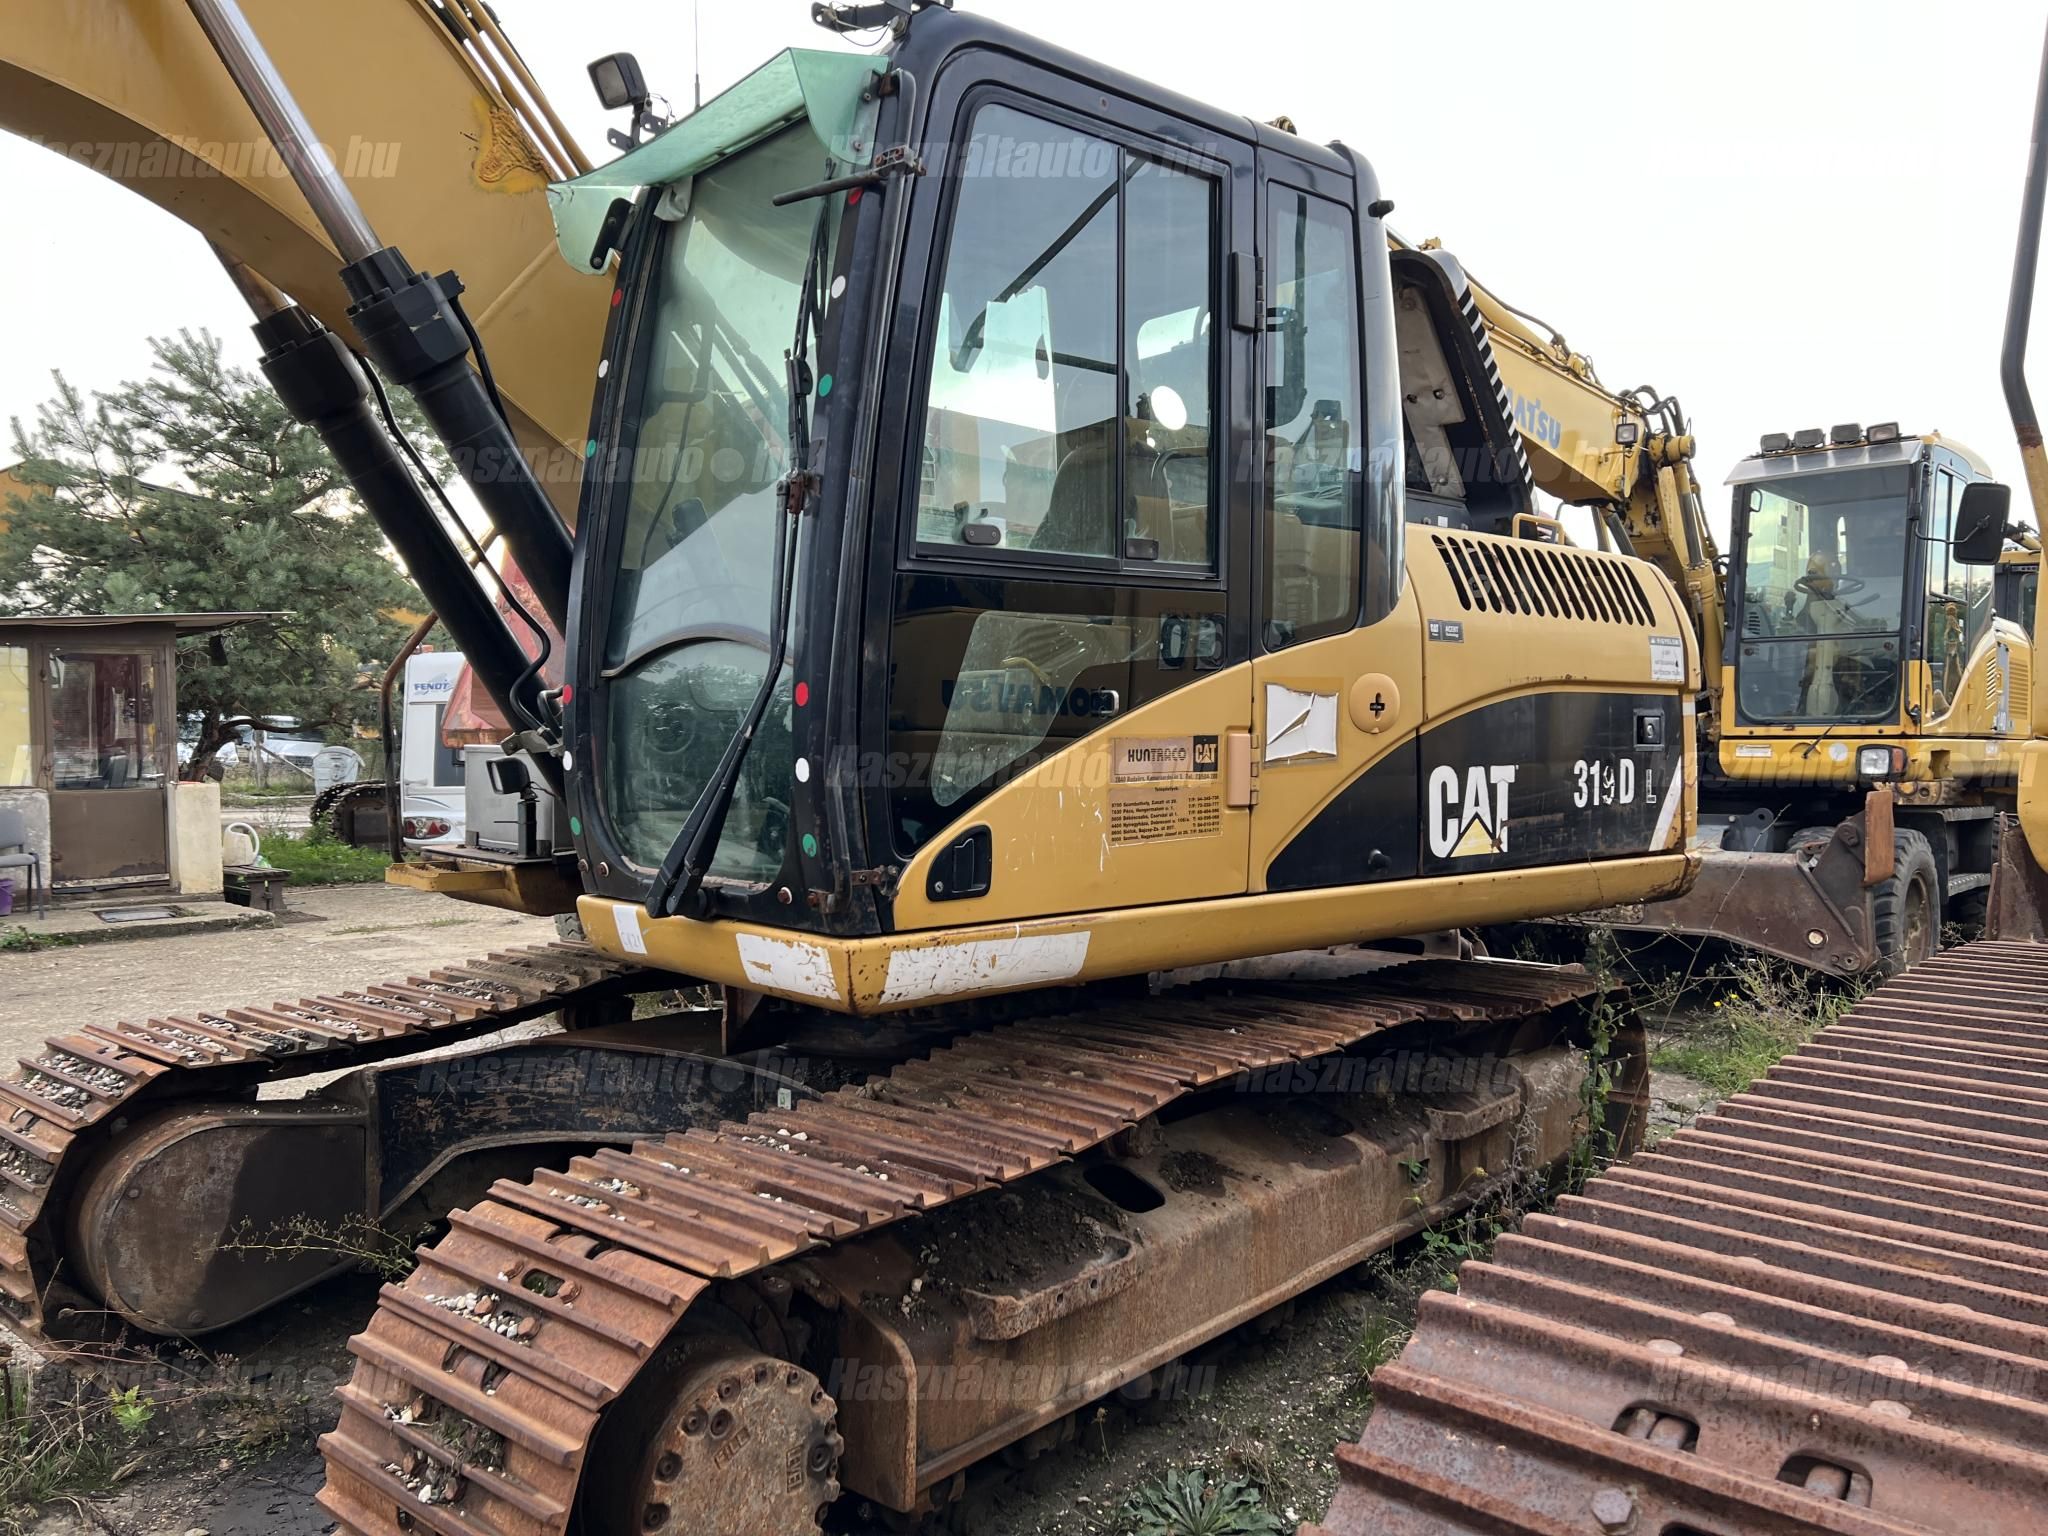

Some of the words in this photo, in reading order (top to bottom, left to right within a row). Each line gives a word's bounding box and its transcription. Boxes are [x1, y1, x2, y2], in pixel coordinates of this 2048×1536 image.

[1128, 747, 1187, 762] HUNTRACO
[1195, 743, 1217, 763] CAT
[1573, 758, 1635, 808] 319D
[1429, 764, 1516, 858] CAT
